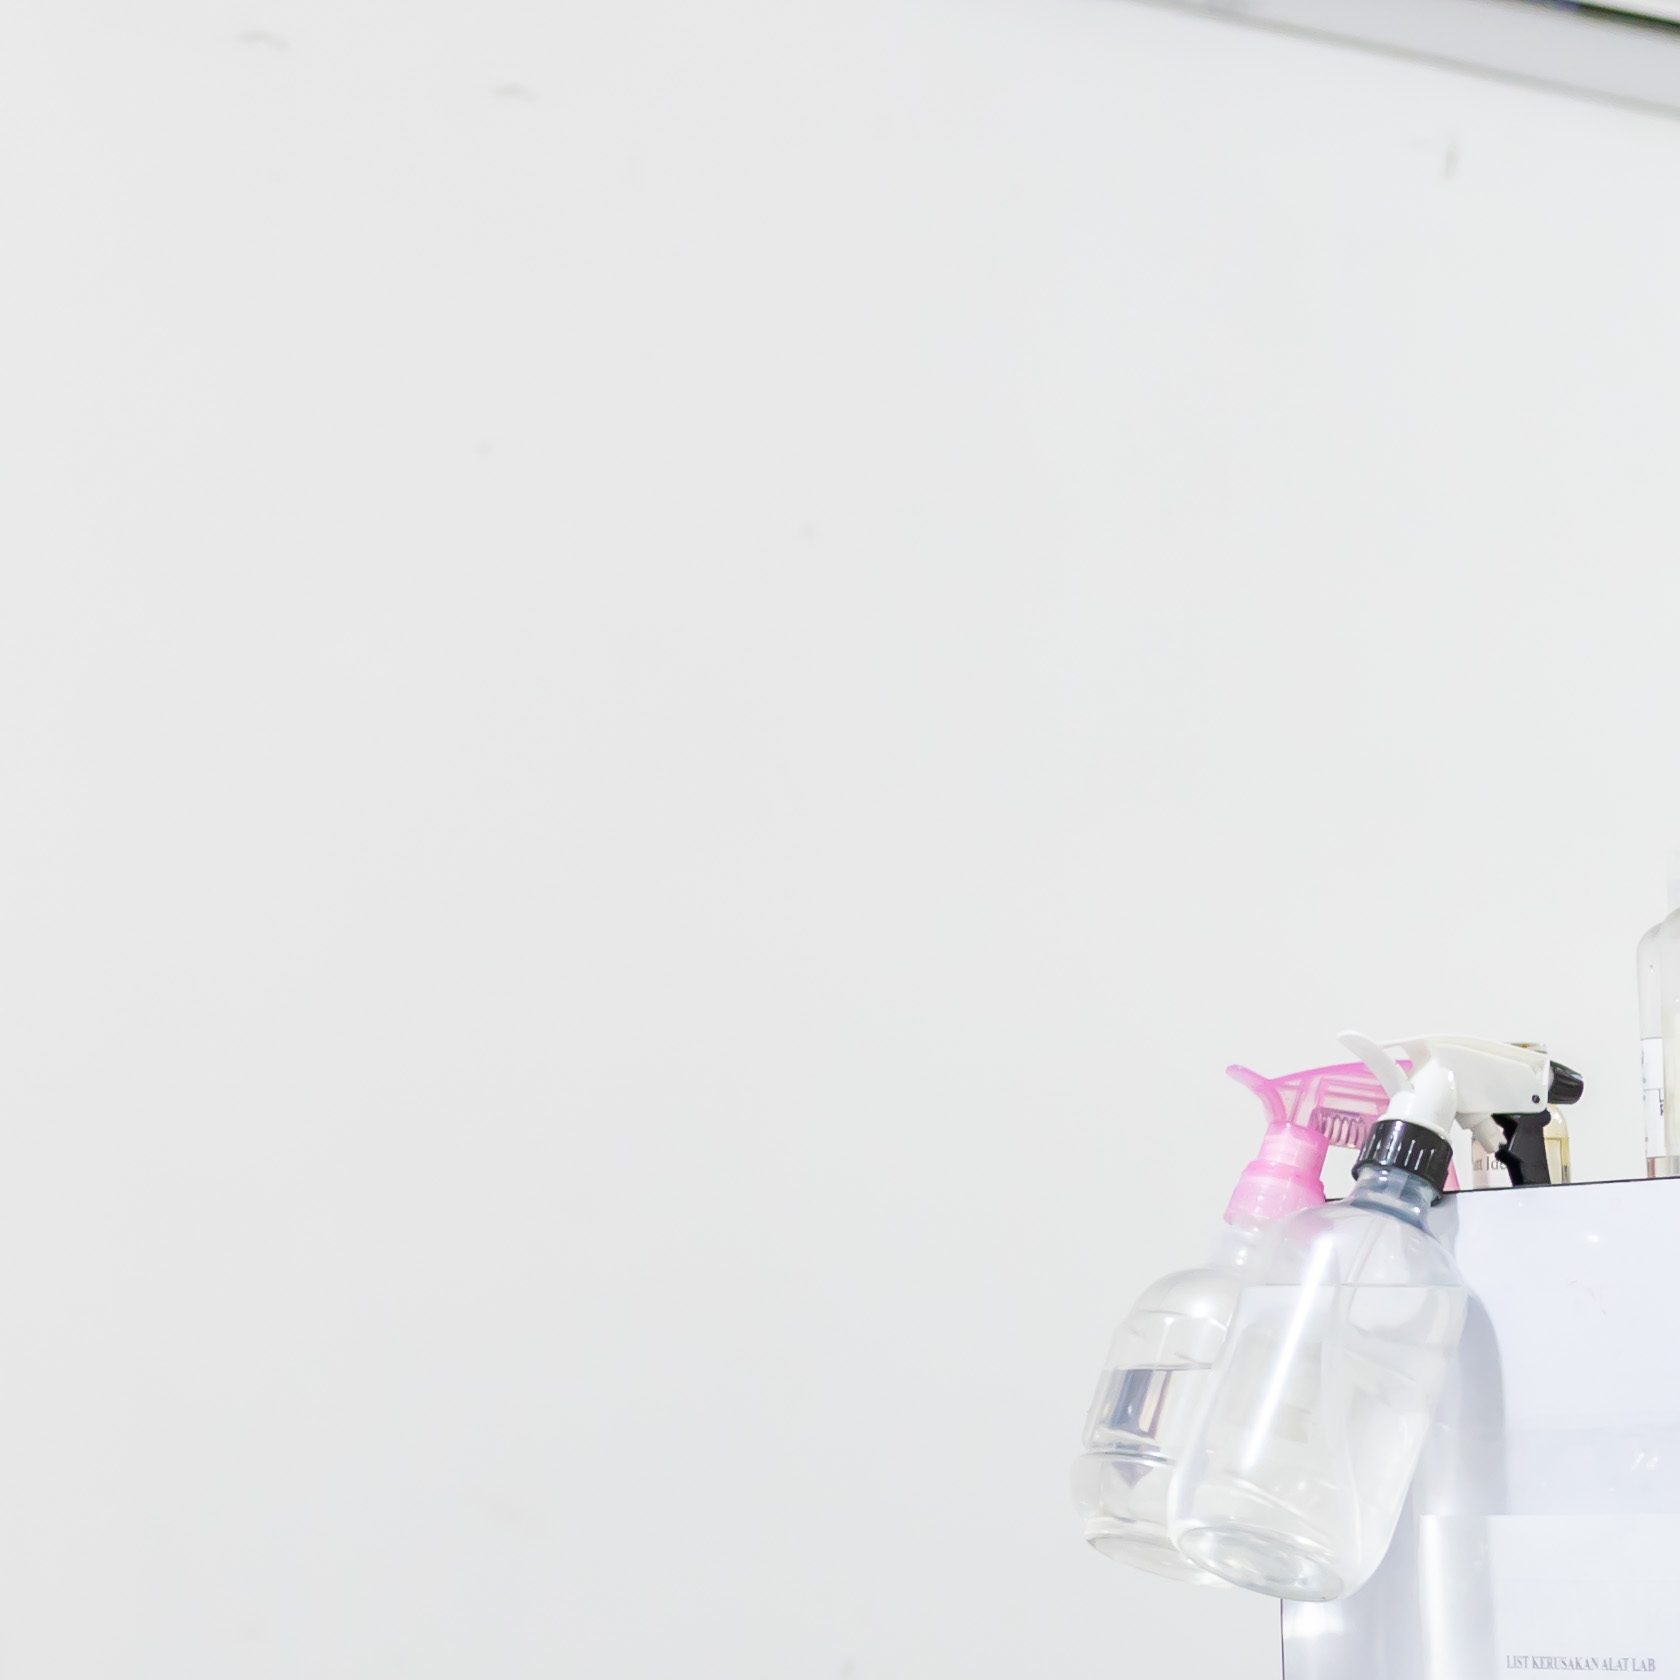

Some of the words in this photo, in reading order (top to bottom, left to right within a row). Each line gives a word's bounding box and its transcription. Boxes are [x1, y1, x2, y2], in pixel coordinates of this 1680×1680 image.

[1506, 1655, 1529, 1670] LIST
[1532, 1656, 1600, 1671] KERUSAKAN
[1602, 1657, 1629, 1671] ALAT
[1631, 1658, 1656, 1672] LAB
